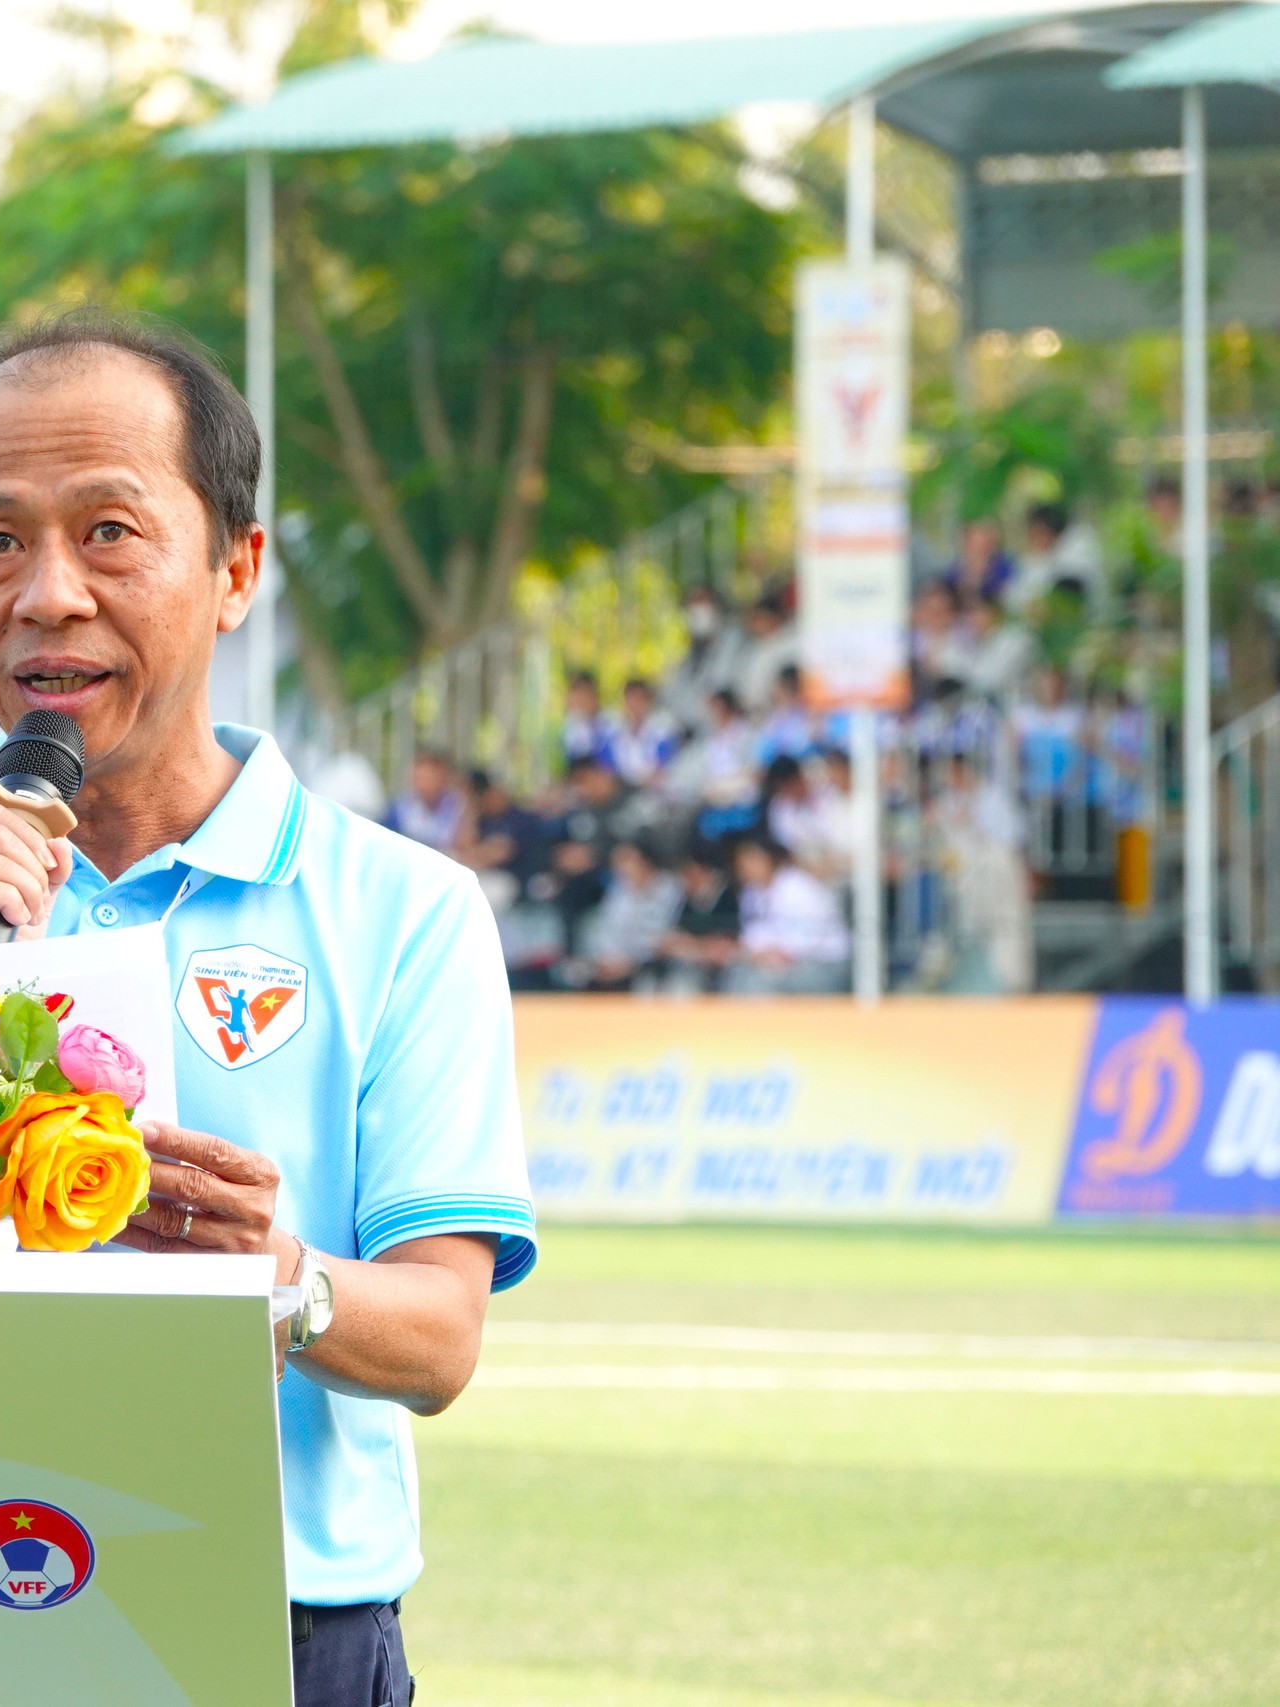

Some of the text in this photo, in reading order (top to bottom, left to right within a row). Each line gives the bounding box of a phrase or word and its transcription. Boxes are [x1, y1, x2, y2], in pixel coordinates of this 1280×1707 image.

[195, 966, 220, 976] SINH
[278, 977, 302, 987] NAM
[8, 1581, 47, 1595] VFF
